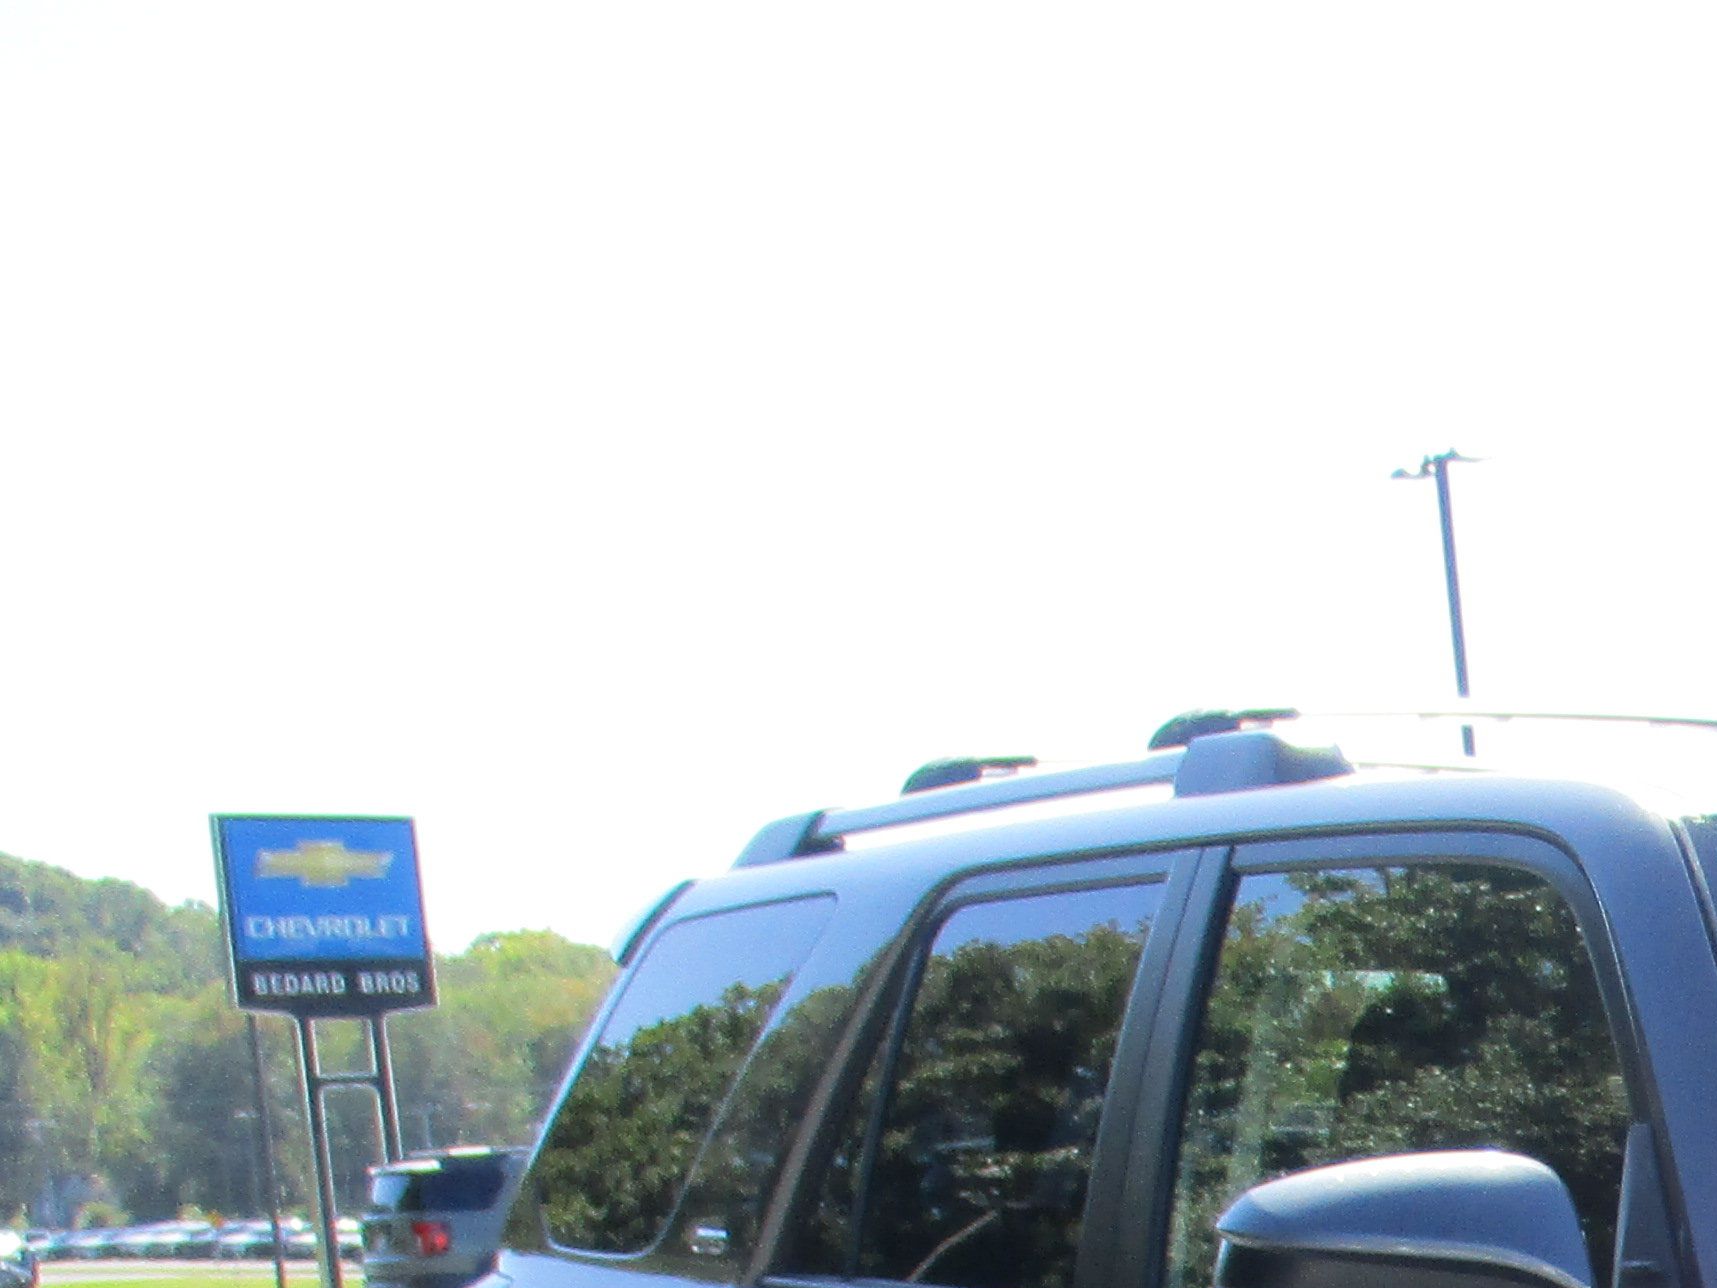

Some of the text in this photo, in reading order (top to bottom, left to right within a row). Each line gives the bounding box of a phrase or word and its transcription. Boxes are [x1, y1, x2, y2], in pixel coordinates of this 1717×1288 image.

[245, 915, 409, 938] CHEVROLET
[254, 971, 421, 995] BEDARD BROS
